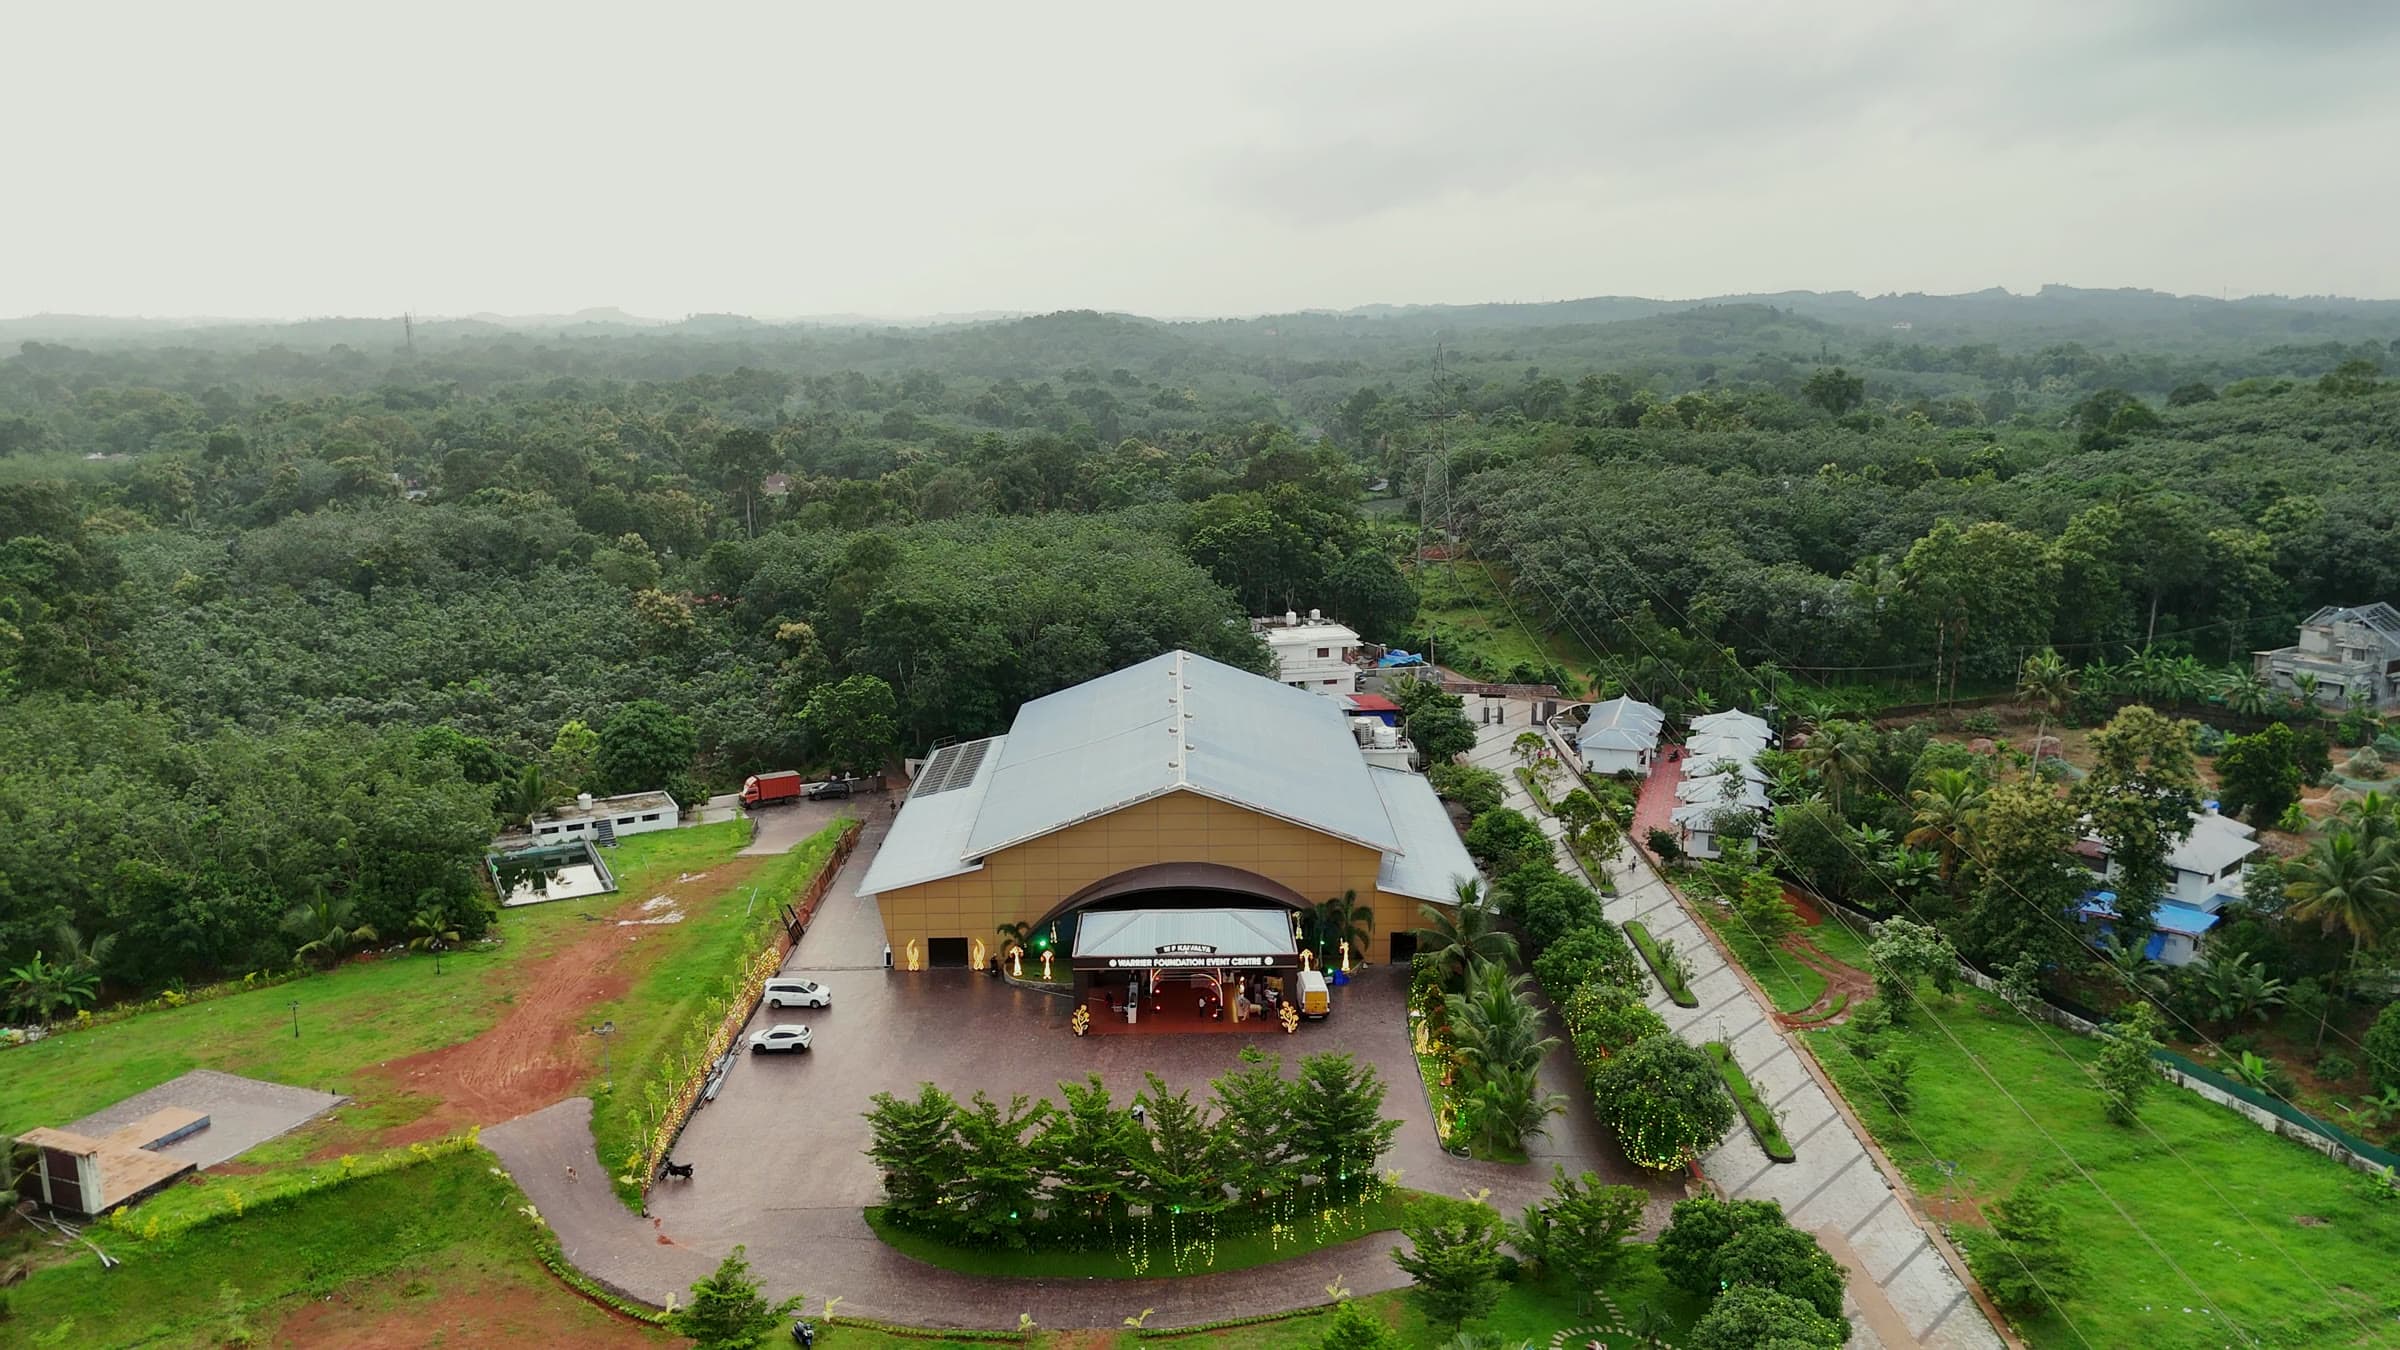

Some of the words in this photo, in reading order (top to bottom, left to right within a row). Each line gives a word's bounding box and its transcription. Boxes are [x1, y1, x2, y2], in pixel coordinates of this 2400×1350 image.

[1117, 959, 1153, 967] WARRIER
[1153, 958, 1205, 967] FOUNDATION
[1206, 958, 1231, 966] EVENT
[1231, 957, 1262, 966] CENTRE
